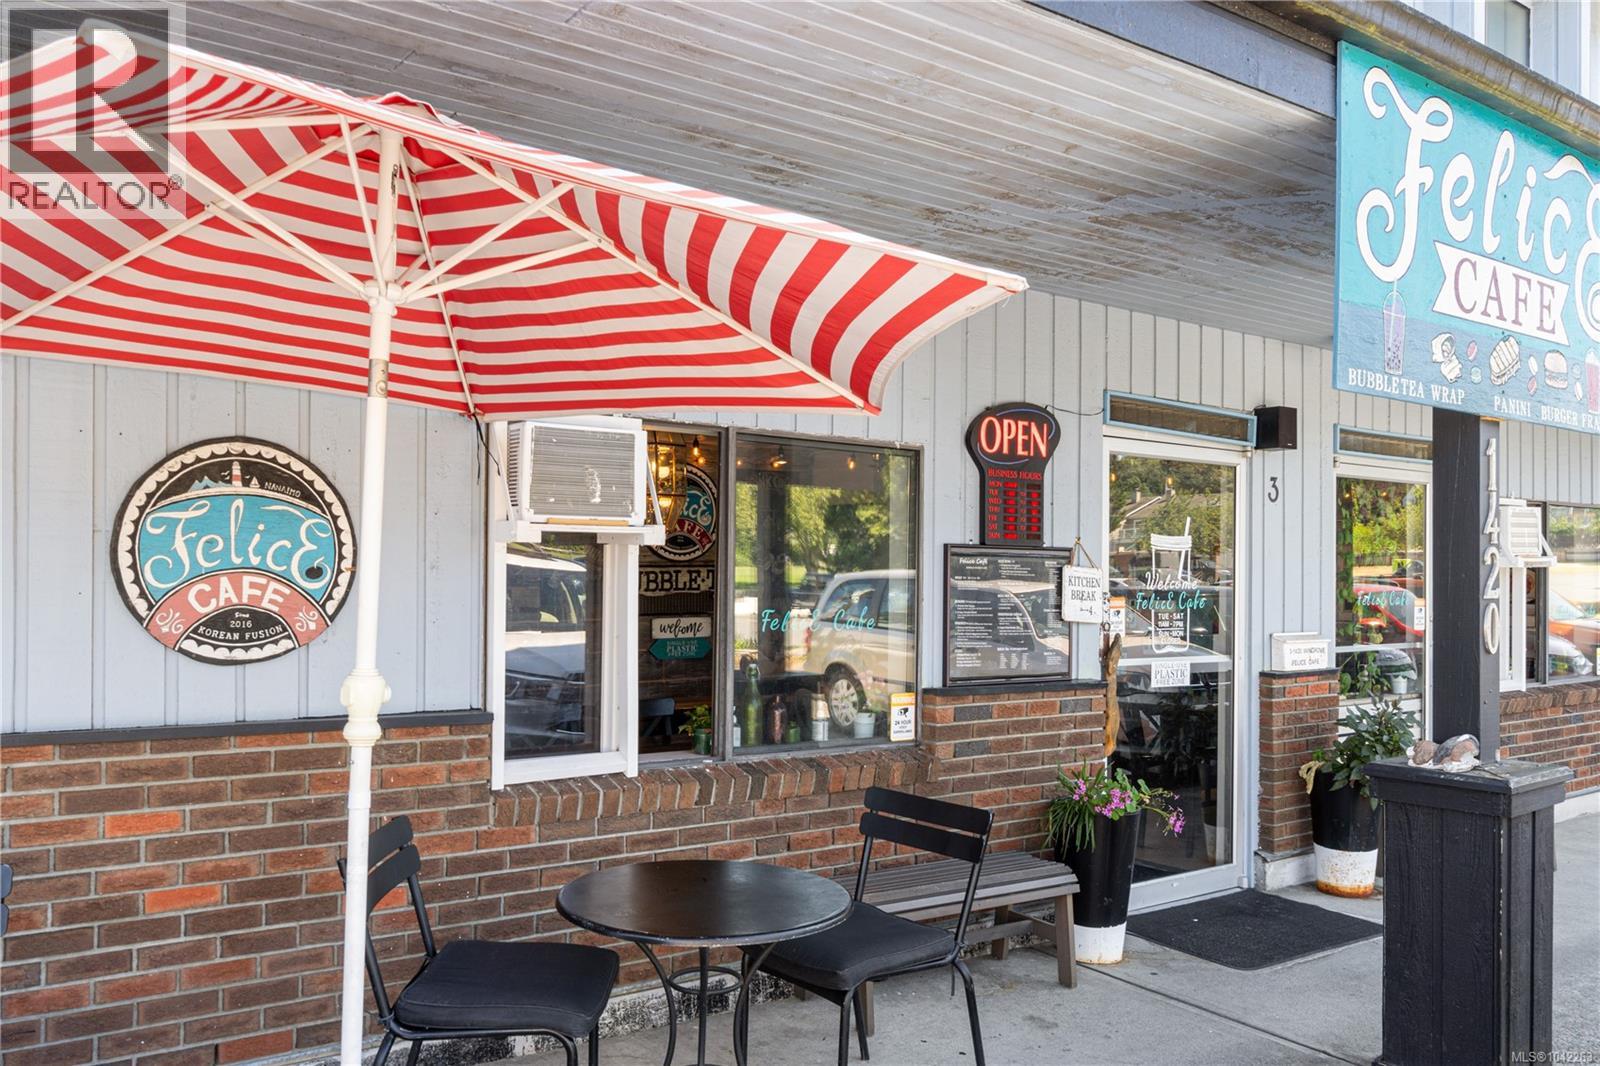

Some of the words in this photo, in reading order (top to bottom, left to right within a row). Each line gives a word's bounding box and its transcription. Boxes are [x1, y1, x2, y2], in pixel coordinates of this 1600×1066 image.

[1453, 257, 1556, 335] CAFE
[1431, 383, 1465, 405] WRAP
[1493, 395, 1531, 418] PANINI
[1541, 405, 1579, 426] BURGER
[979, 415, 1049, 459] OPEN
[987, 467, 1018, 479] BUSINESS
[1019, 471, 1042, 481] HOURS
[264, 481, 301, 498] NANAIMO
[1267, 476, 1279, 503] 3
[1068, 575, 1101, 588] KITCHEN
[1145, 571, 1198, 590] Welcome
[187, 575, 291, 613] CAFE
[1071, 589, 1097, 601] BREAK
[1179, 589, 1207, 609] Cafe
[229, 620, 253, 629] 2016
[659, 617, 703, 638] welcome
[833, 605, 877, 632] Cafe
[198, 625, 240, 640] KOREAN
[245, 624, 283, 640] FUSION
[1154, 668, 1188, 680] PLASTIC
